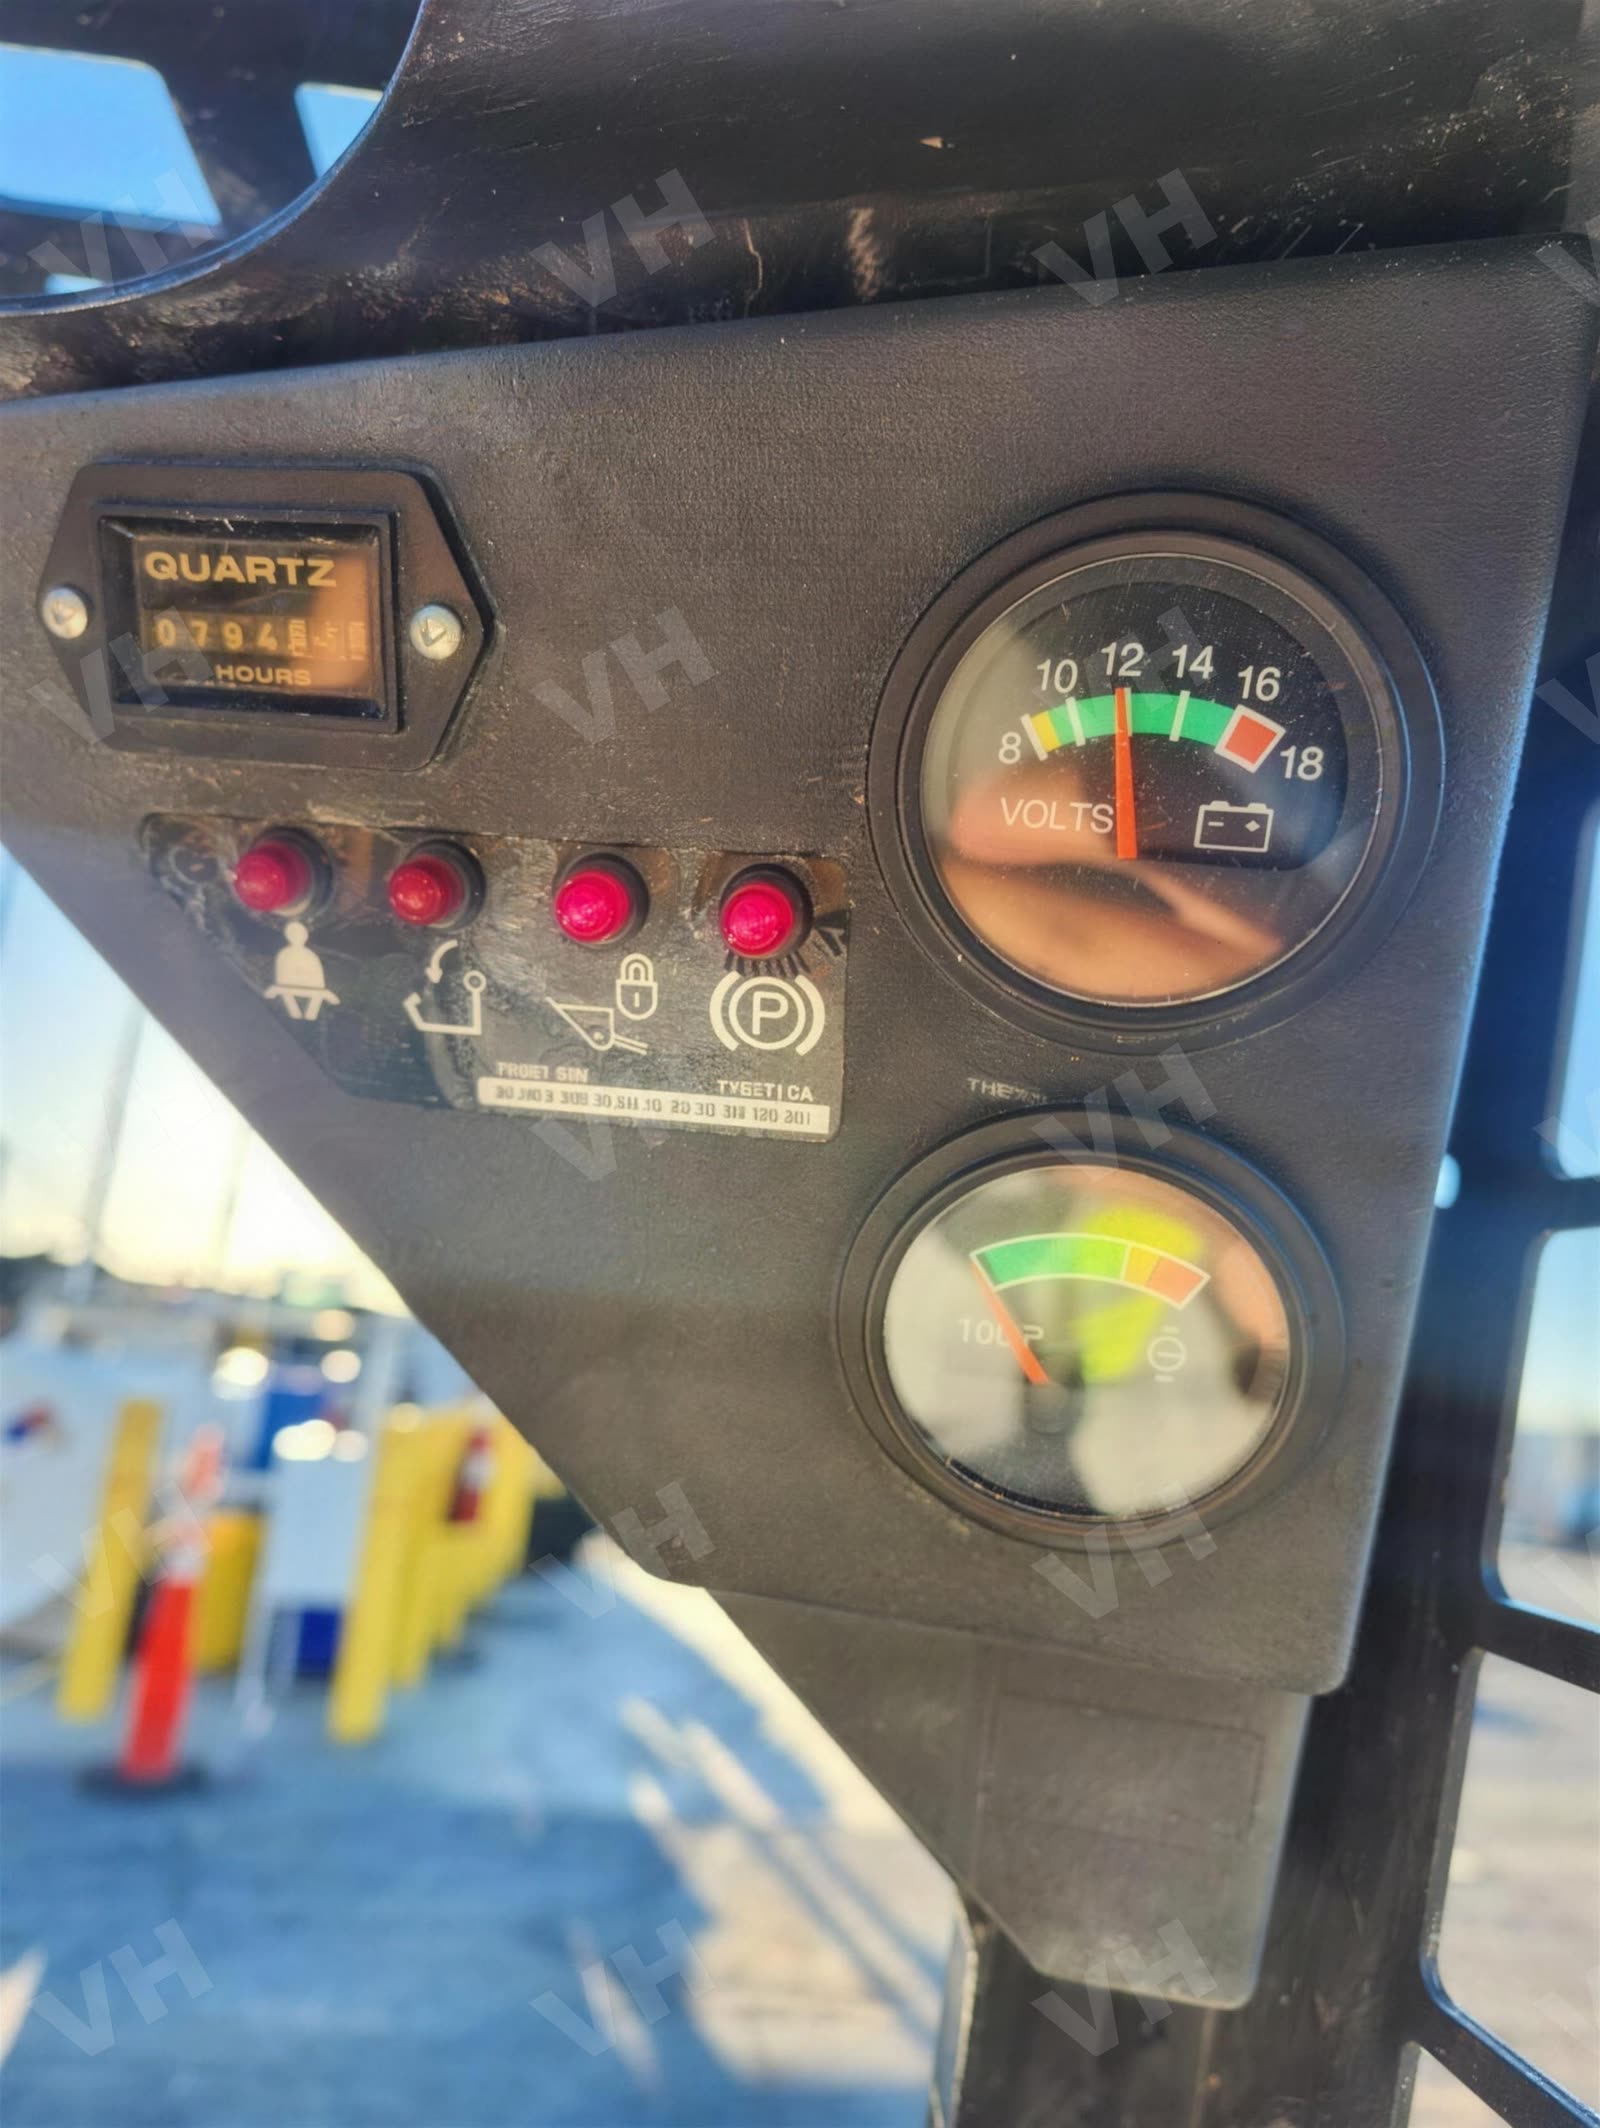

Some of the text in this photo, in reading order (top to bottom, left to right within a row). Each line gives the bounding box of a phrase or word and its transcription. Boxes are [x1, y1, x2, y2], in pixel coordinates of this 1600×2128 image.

[144, 551, 338, 588] QUARTZ
[215, 663, 313, 687] HOURS
[1036, 658, 1079, 694] 10
[1100, 641, 1145, 678] 12
[1171, 643, 1214, 680] 14
[1237, 665, 1282, 702] 16
[998, 731, 1022, 765] 8
[1279, 745, 1325, 782] 18
[1000, 797, 1115, 835] VOLTS
